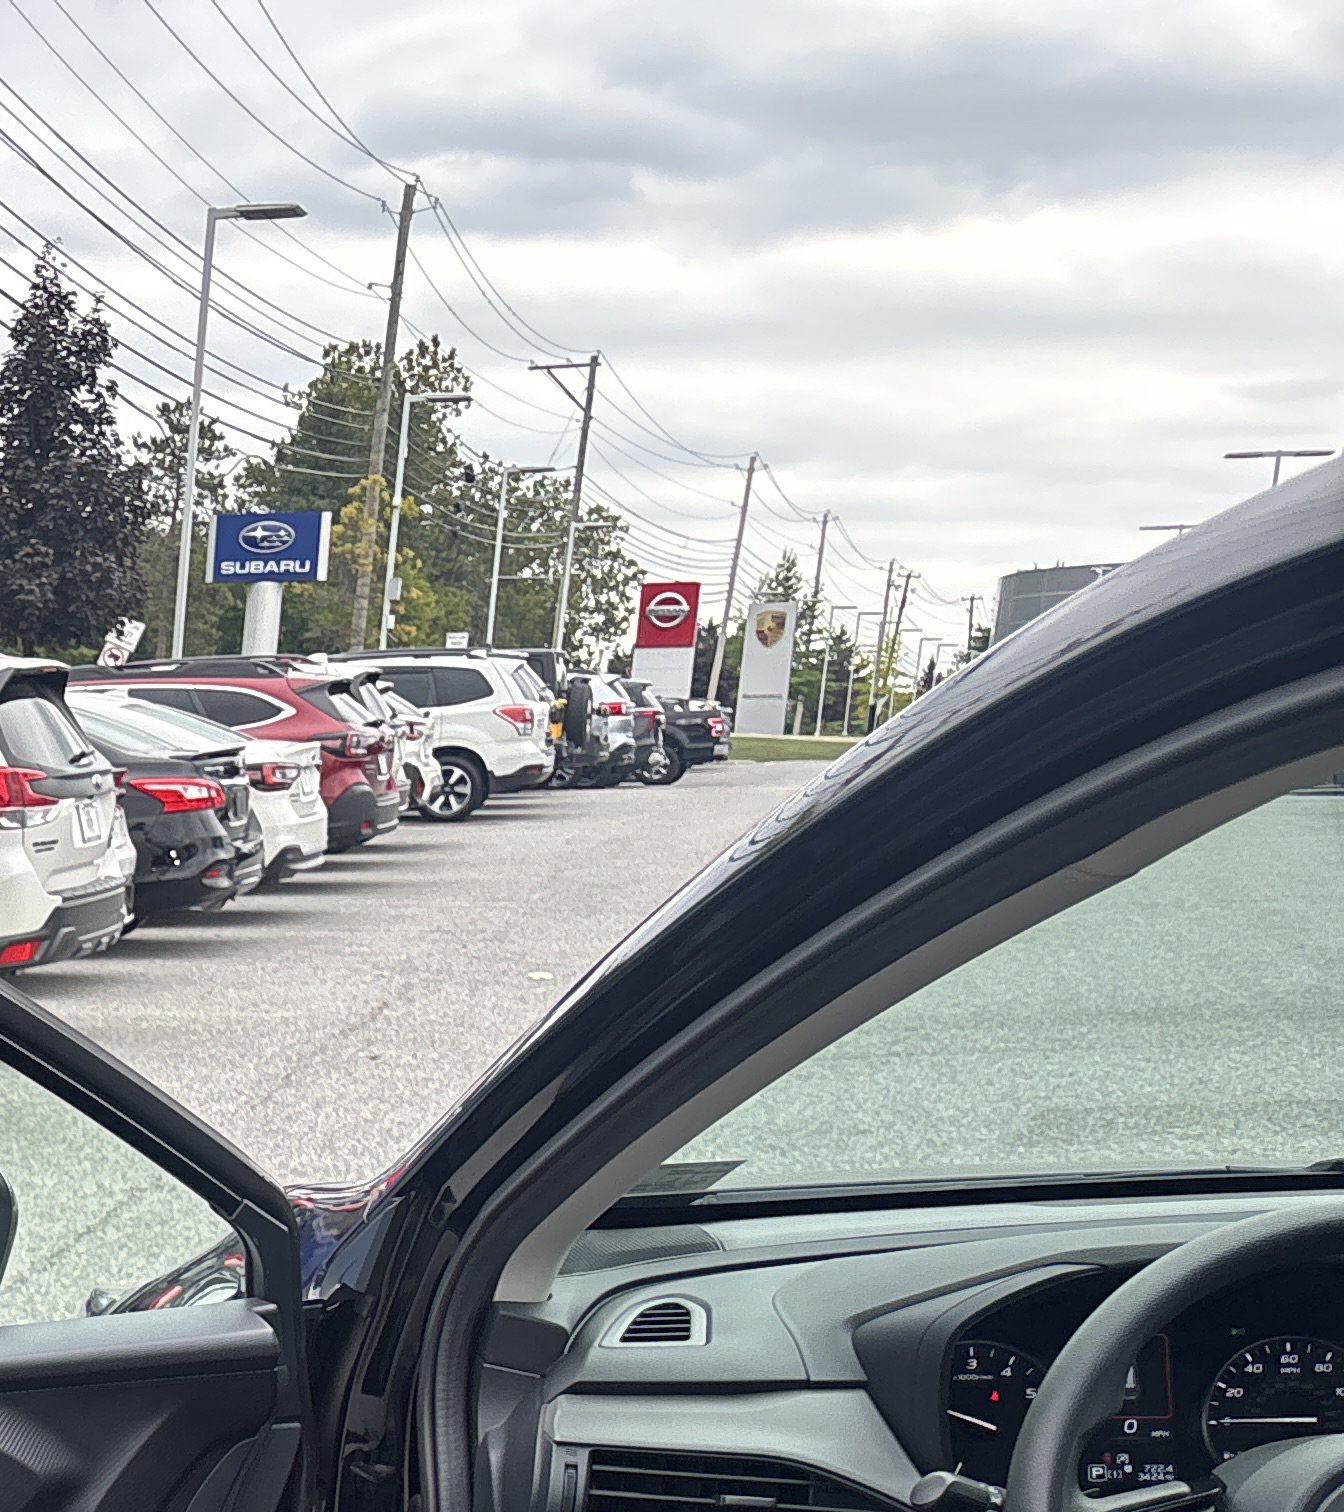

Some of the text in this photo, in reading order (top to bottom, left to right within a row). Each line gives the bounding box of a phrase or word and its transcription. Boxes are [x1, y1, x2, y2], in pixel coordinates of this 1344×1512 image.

[220, 559, 311, 575] SUBARU
[965, 1358, 978, 1370] 3
[1280, 1354, 1299, 1364] 60
[1000, 1366, 1013, 1377] 4
[1243, 1363, 1264, 1373] 40
[1313, 1363, 1333, 1373] 80
[1025, 1388, 1037, 1399] 5
[1225, 1388, 1244, 1398] 20
[1122, 1418, 1138, 1434] 0
[1091, 1467, 1104, 1478] P
